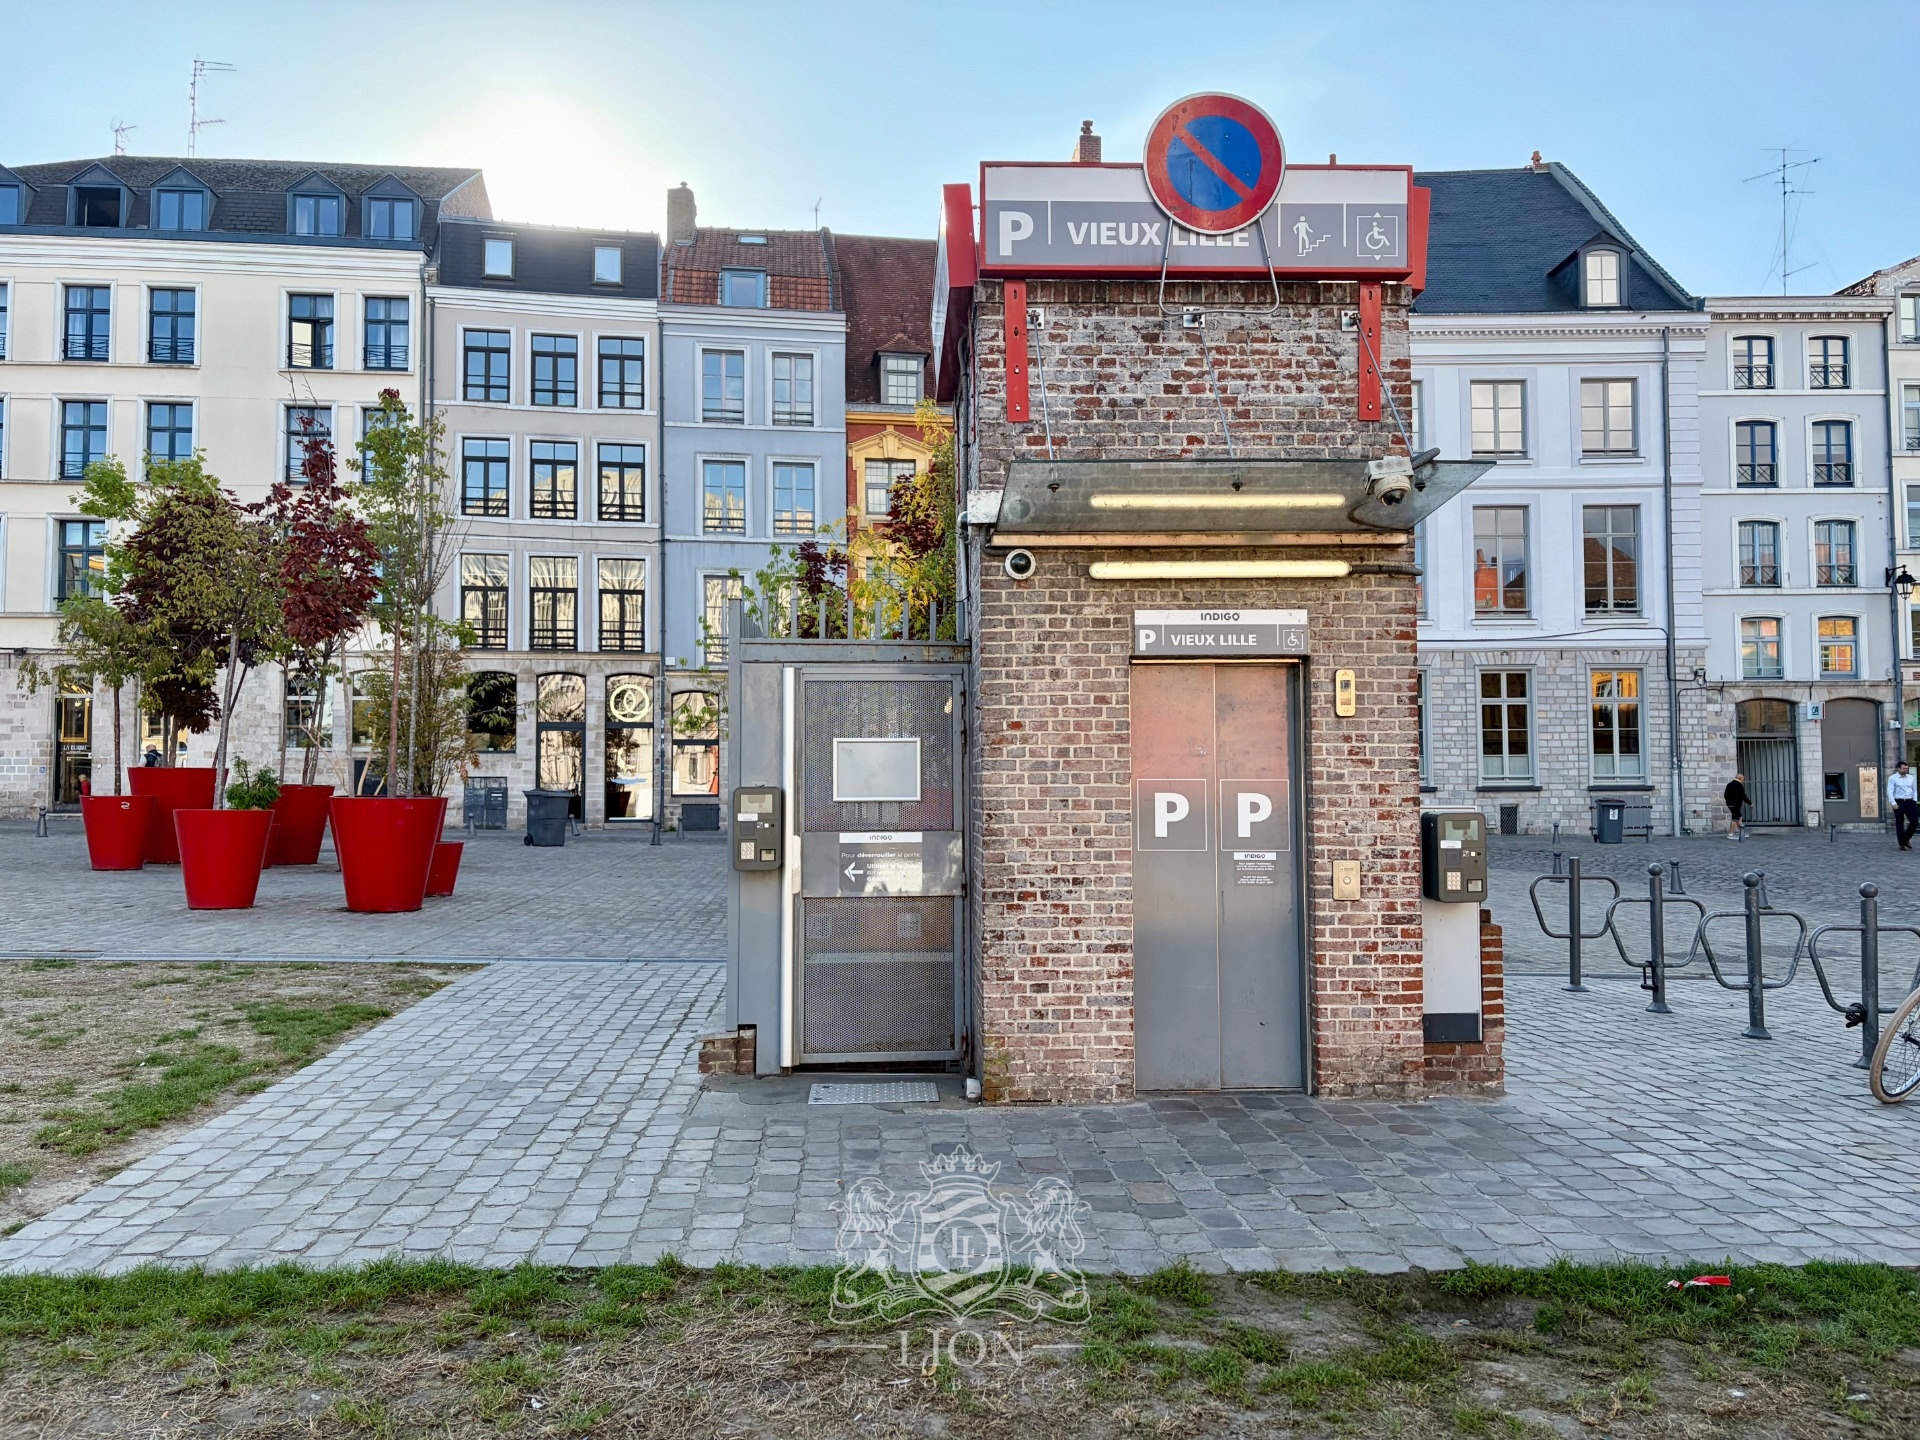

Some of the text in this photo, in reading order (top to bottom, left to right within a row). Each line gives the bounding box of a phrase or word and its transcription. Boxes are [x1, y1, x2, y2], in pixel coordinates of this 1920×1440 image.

[999, 210, 1034, 256] P
[1067, 222, 1163, 246] VIEUX
[1200, 612, 1240, 622] INDIGO
[1139, 629, 1157, 651] P
[1170, 634, 1257, 646] VIEUX LILLE
[1154, 792, 1190, 838] P
[1237, 792, 1273, 838] P
